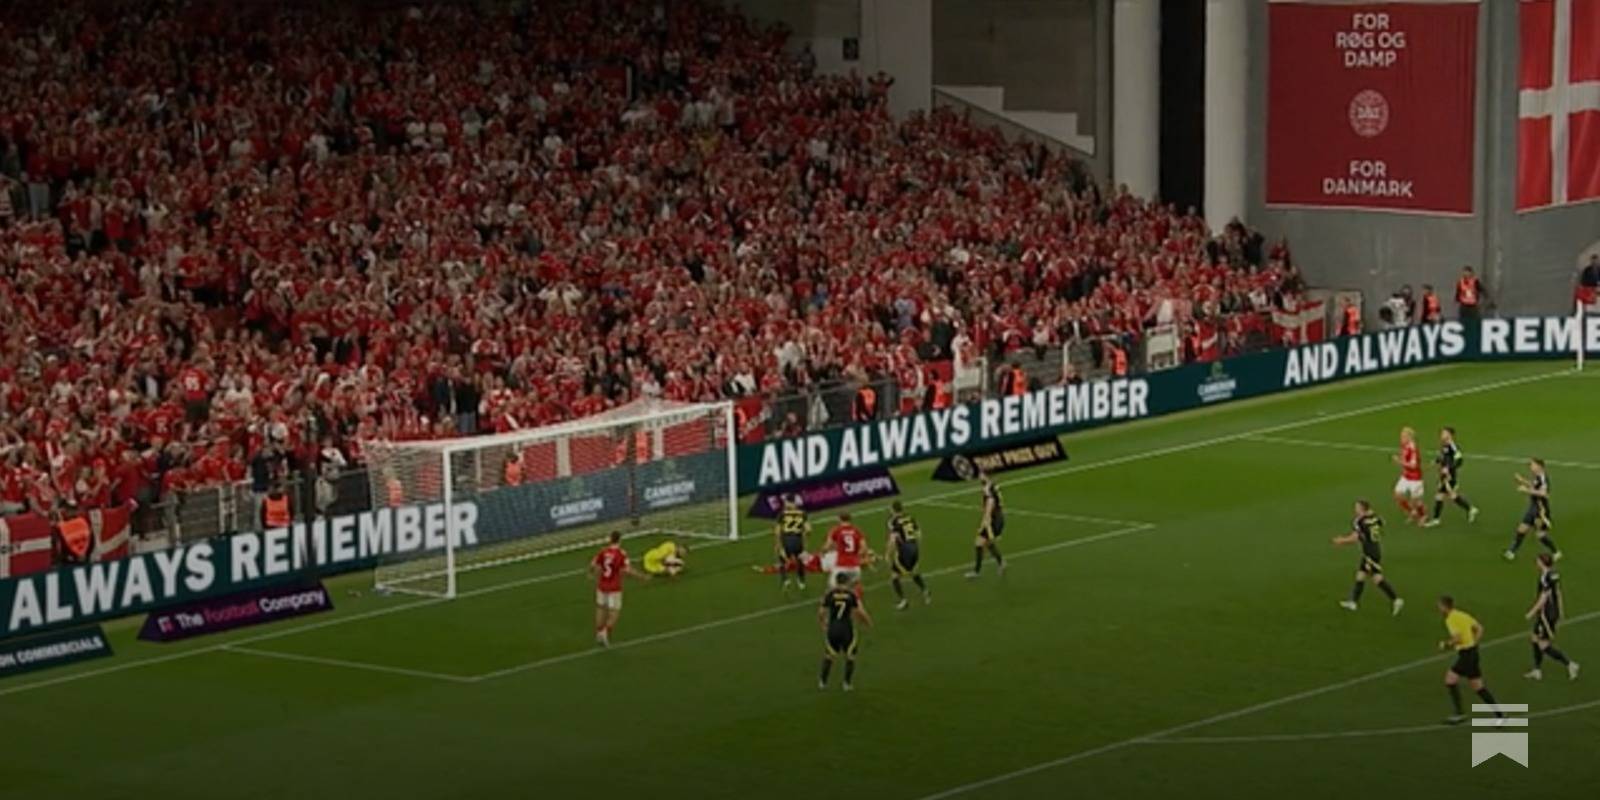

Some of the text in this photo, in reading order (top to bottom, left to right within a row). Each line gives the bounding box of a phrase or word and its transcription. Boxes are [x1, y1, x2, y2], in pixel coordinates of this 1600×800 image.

[1353, 13, 1389, 30] FOR
[1335, 32, 1406, 48] RØG OG
[1345, 51, 1397, 67] DAMP
[1350, 160, 1386, 178] FOR
[1322, 178, 1413, 198] DANMARK
[1284, 342, 1339, 387] AND
[1344, 321, 1465, 381] ALWAYS
[758, 377, 1149, 487] AND ALWAYS REMEMBER
[842, 477, 893, 496] Company
[783, 515, 803, 532] 22
[843, 535, 856, 552] 9
[8, 501, 478, 632] ALWAYS REMEMBER
[174, 590, 325, 630] The Football Company
[834, 600, 847, 620] 7
[16, 636, 105, 664] COMMERCIALS
